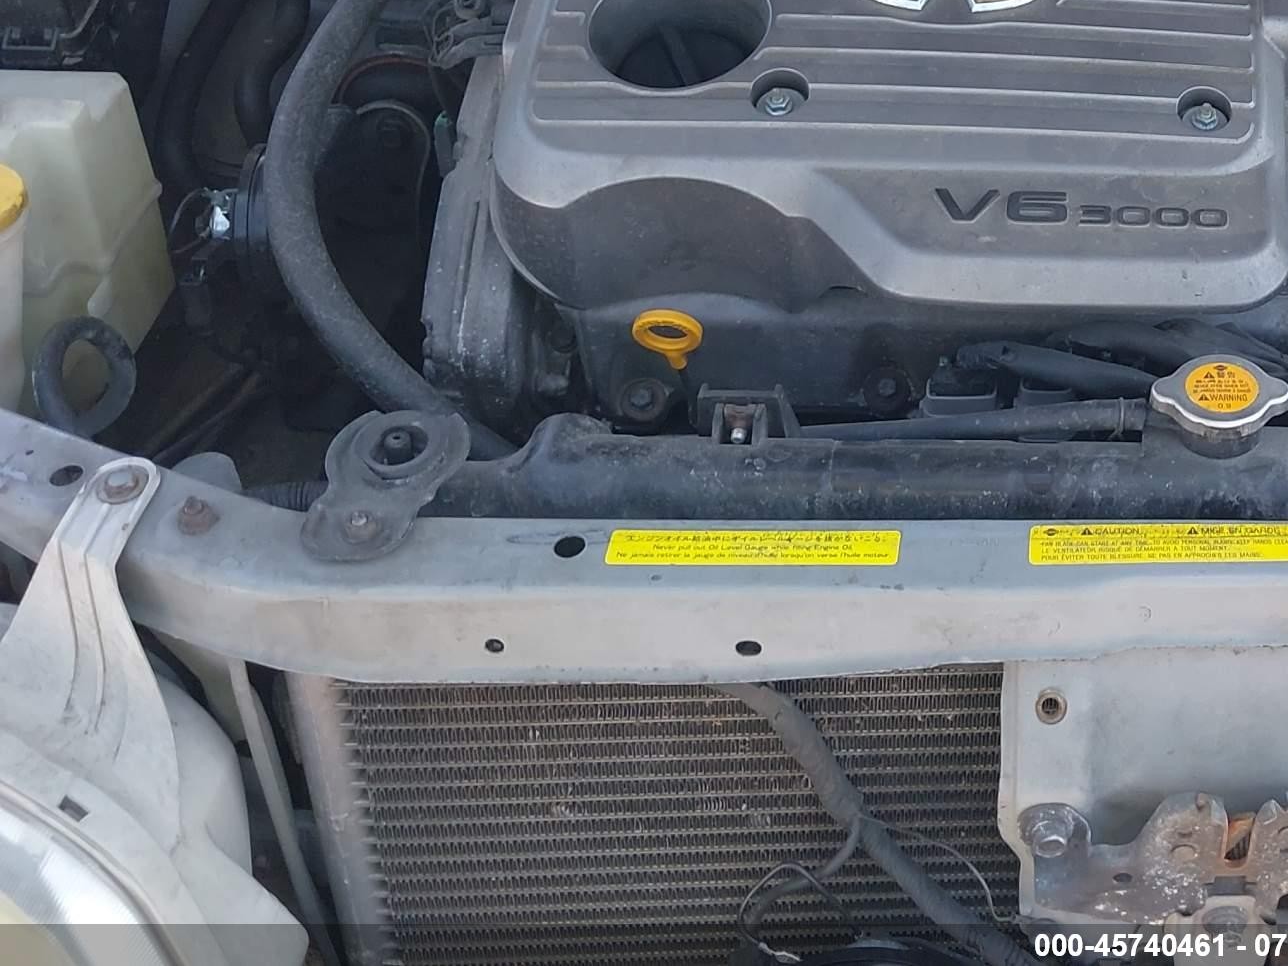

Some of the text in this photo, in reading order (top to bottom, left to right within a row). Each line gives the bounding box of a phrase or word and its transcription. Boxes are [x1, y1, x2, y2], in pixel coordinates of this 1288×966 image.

[934, 187, 1229, 229] V6 3000
[1209, 394, 1248, 402] WARNING
[1094, 527, 1140, 535] CAUTION
